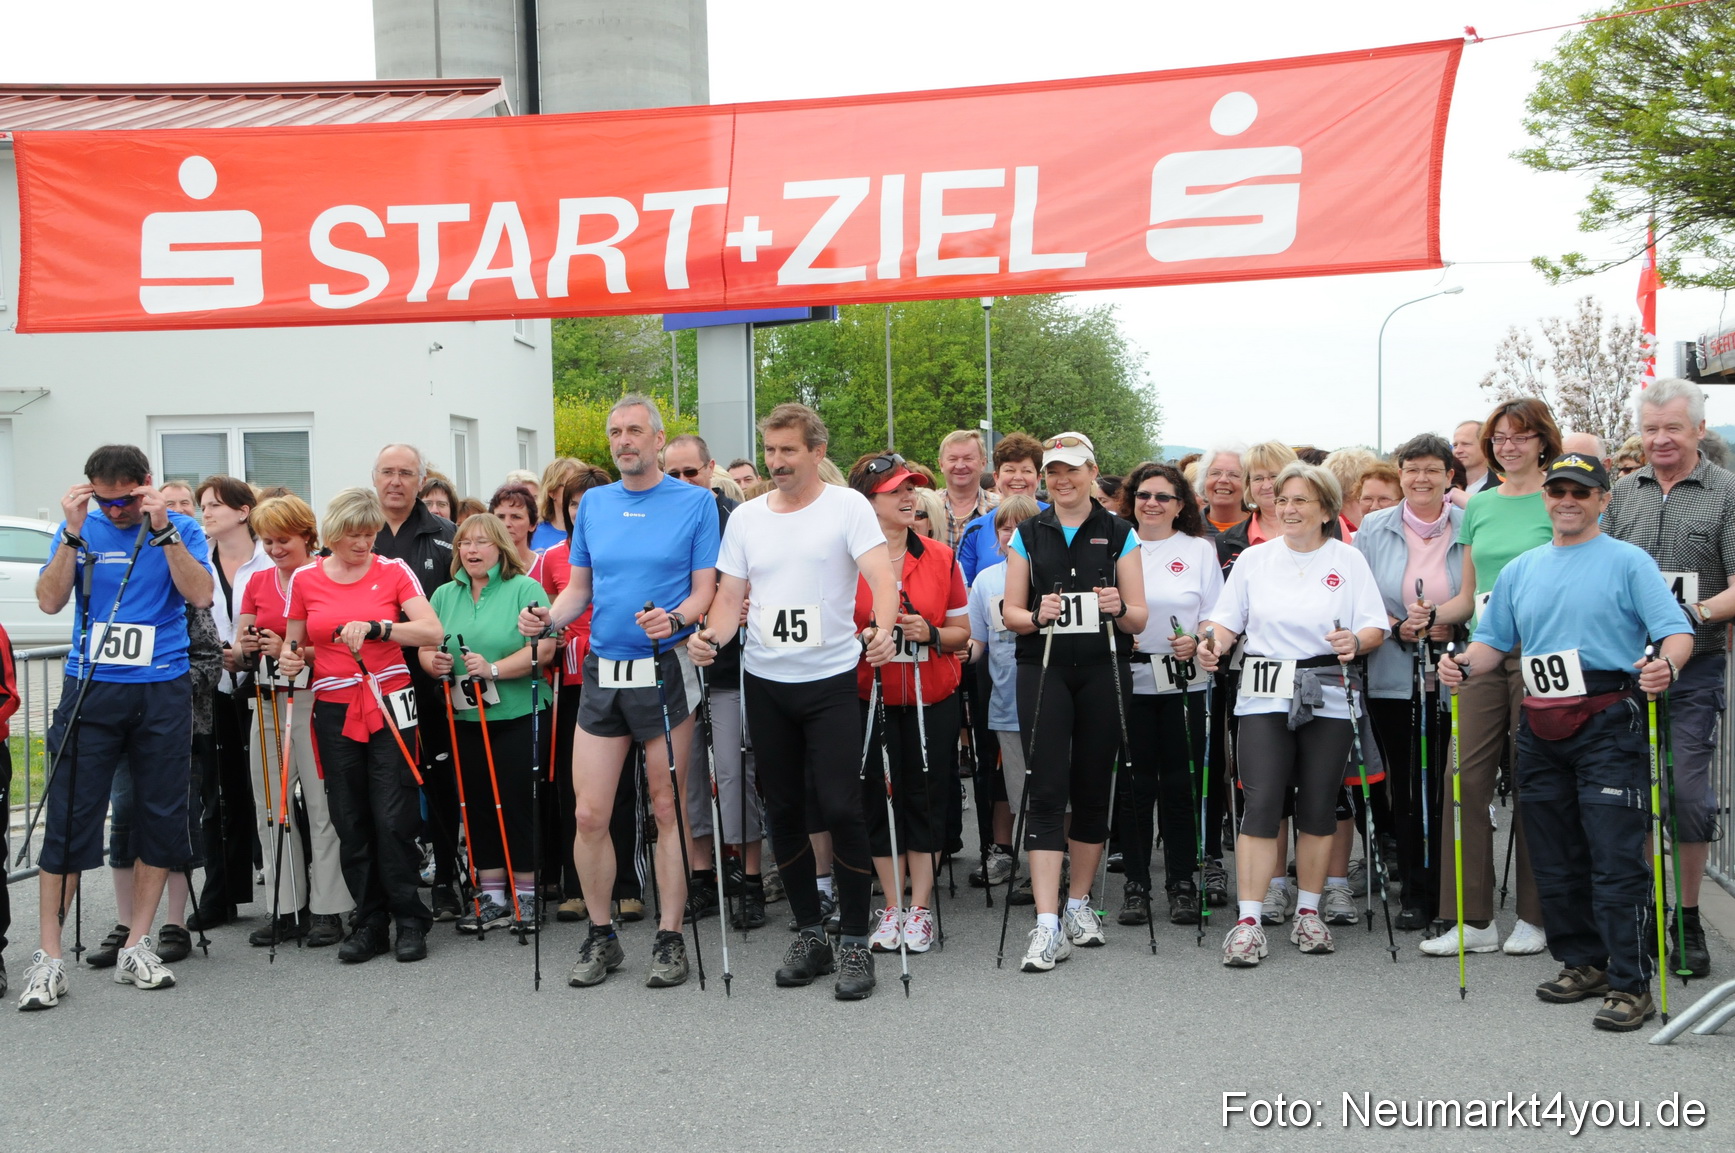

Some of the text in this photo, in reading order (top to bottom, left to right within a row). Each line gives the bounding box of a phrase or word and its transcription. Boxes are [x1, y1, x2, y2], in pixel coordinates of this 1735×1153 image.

[104, 626, 142, 660] 50
[773, 609, 808, 643] 45
[1253, 660, 1282, 693] 117
[1530, 654, 1569, 693] 89
